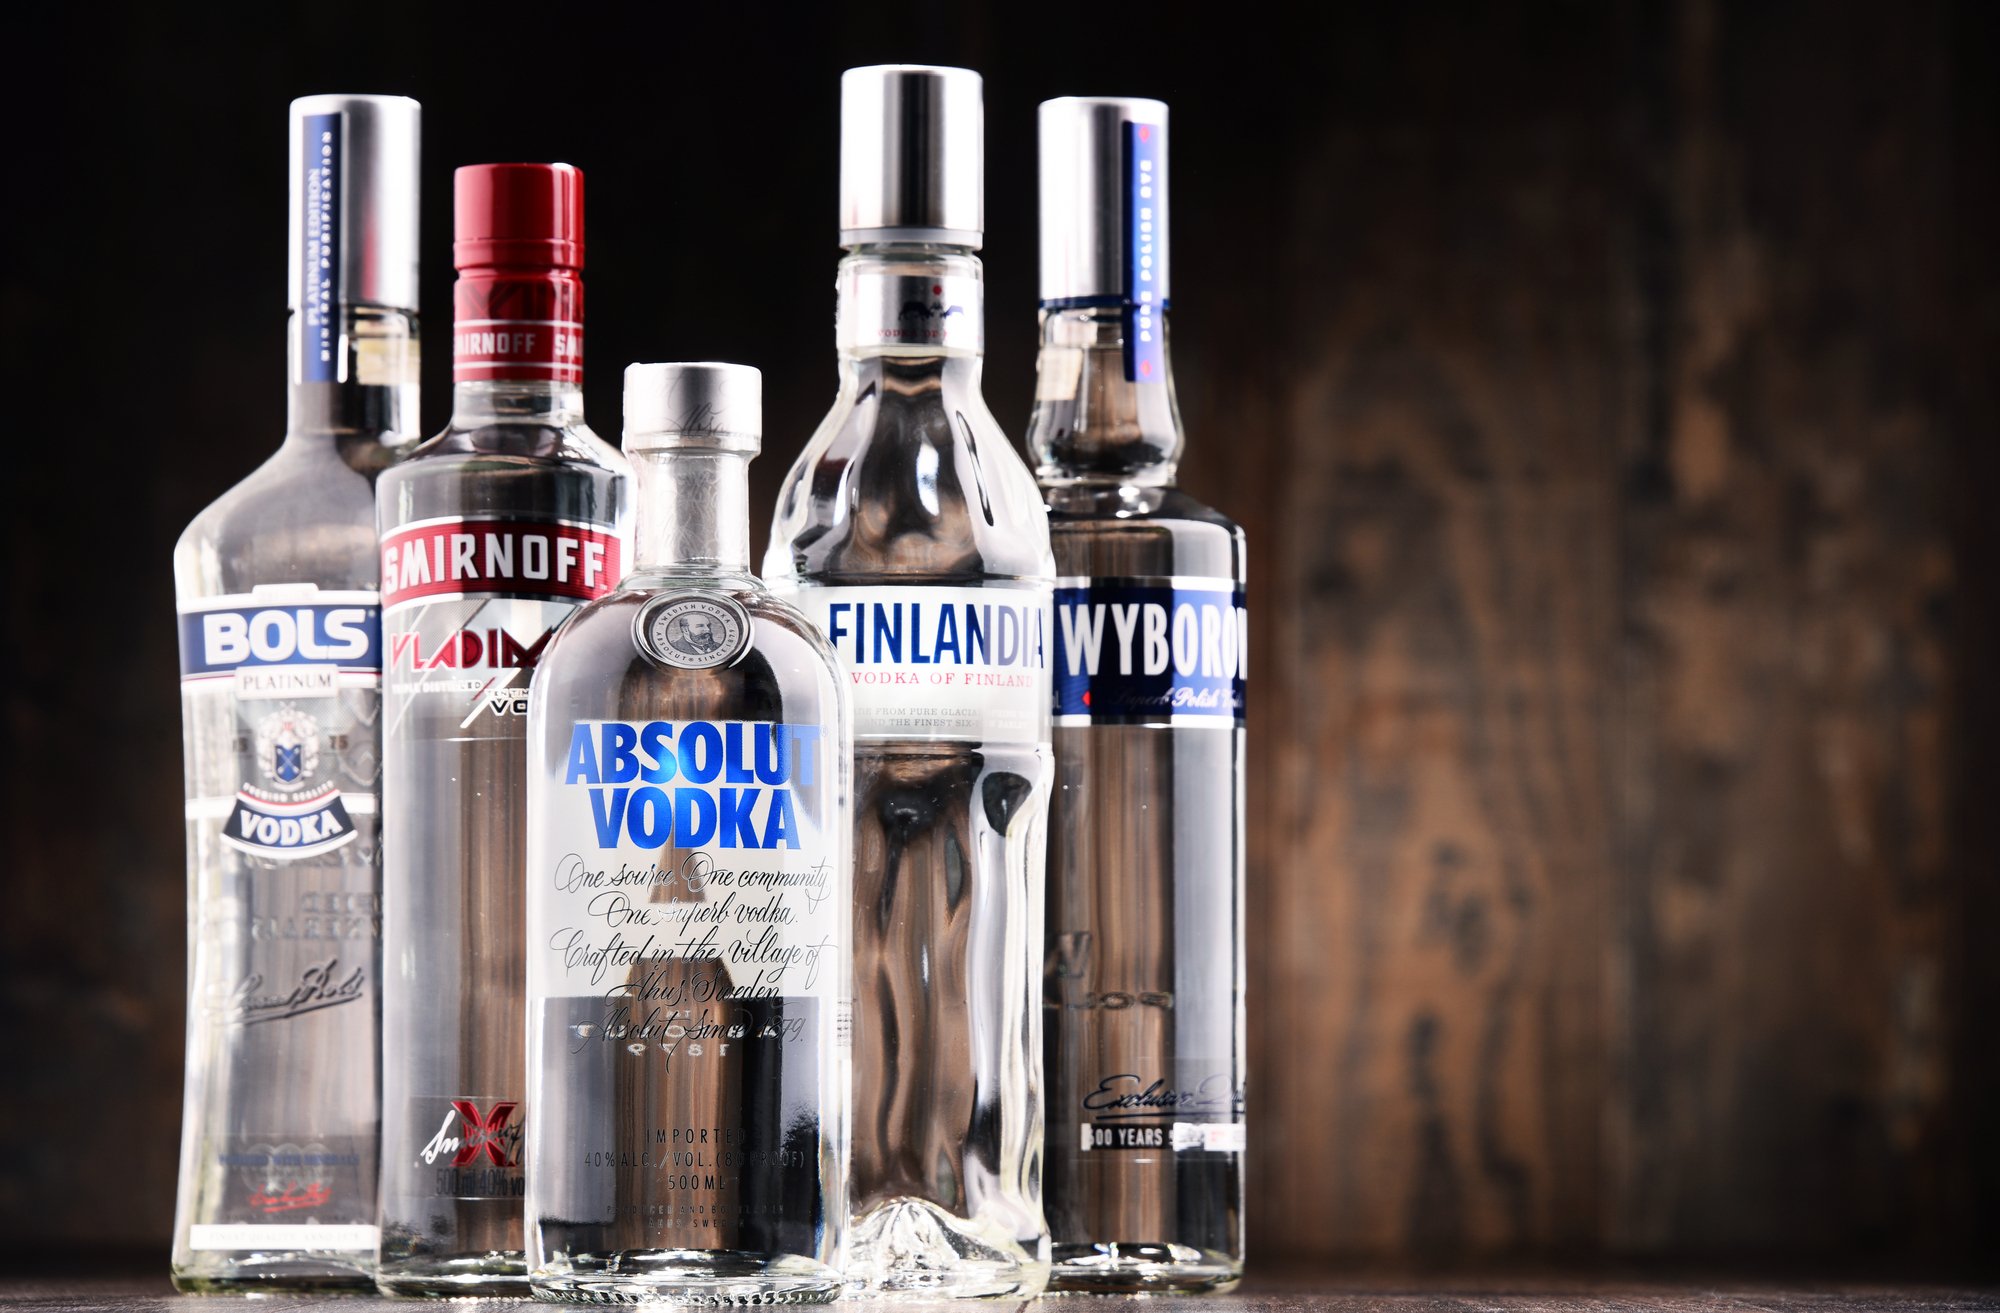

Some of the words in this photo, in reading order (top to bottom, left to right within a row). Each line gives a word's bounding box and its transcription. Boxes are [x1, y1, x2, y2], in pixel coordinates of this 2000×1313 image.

[308, 168, 321, 238] EDITION
[321, 131, 331, 268] PURIFICATION
[308, 239, 320, 326] PLATINUM
[385, 533, 605, 596] SMIRNOFF
[659, 603, 696, 626] SWEDISH
[701, 604, 731, 624] VODKA
[203, 608, 369, 665] BOLS
[656, 631, 686, 661] ABSOLUT
[697, 648, 726, 662] SINCE
[829, 602, 1044, 669] FINLANDIA
[243, 672, 332, 690] PLATINUM
[851, 672, 920, 685] VODKA
[930, 672, 955, 685] OF
[965, 673, 1033, 688] FINLAND
[875, 708, 906, 716] FROM
[910, 708, 937, 716] PURE
[941, 708, 977, 717] GLACIA
[890, 719, 910, 727] THE
[914, 719, 951, 727] FINEST
[565, 721, 822, 786] ABSOLUT
[240, 809, 343, 847] VODKA
[588, 786, 801, 850] VODKA
[554, 853, 604, 893] One
[682, 851, 735, 893] One
[588, 890, 651, 928] One
[734, 893, 798, 924] vodka.
[549, 926, 645, 986] Crafted
[650, 943, 674, 965] in
[675, 925, 724, 963] the
[728, 925, 804, 983] village
[805, 934, 839, 990] of
[572, 1008, 685, 1073] Absolut
[646, 1128, 748, 1144] IMPORTED
[1118, 1128, 1163, 1147] YEARS
[681, 1205, 704, 1214] AND
